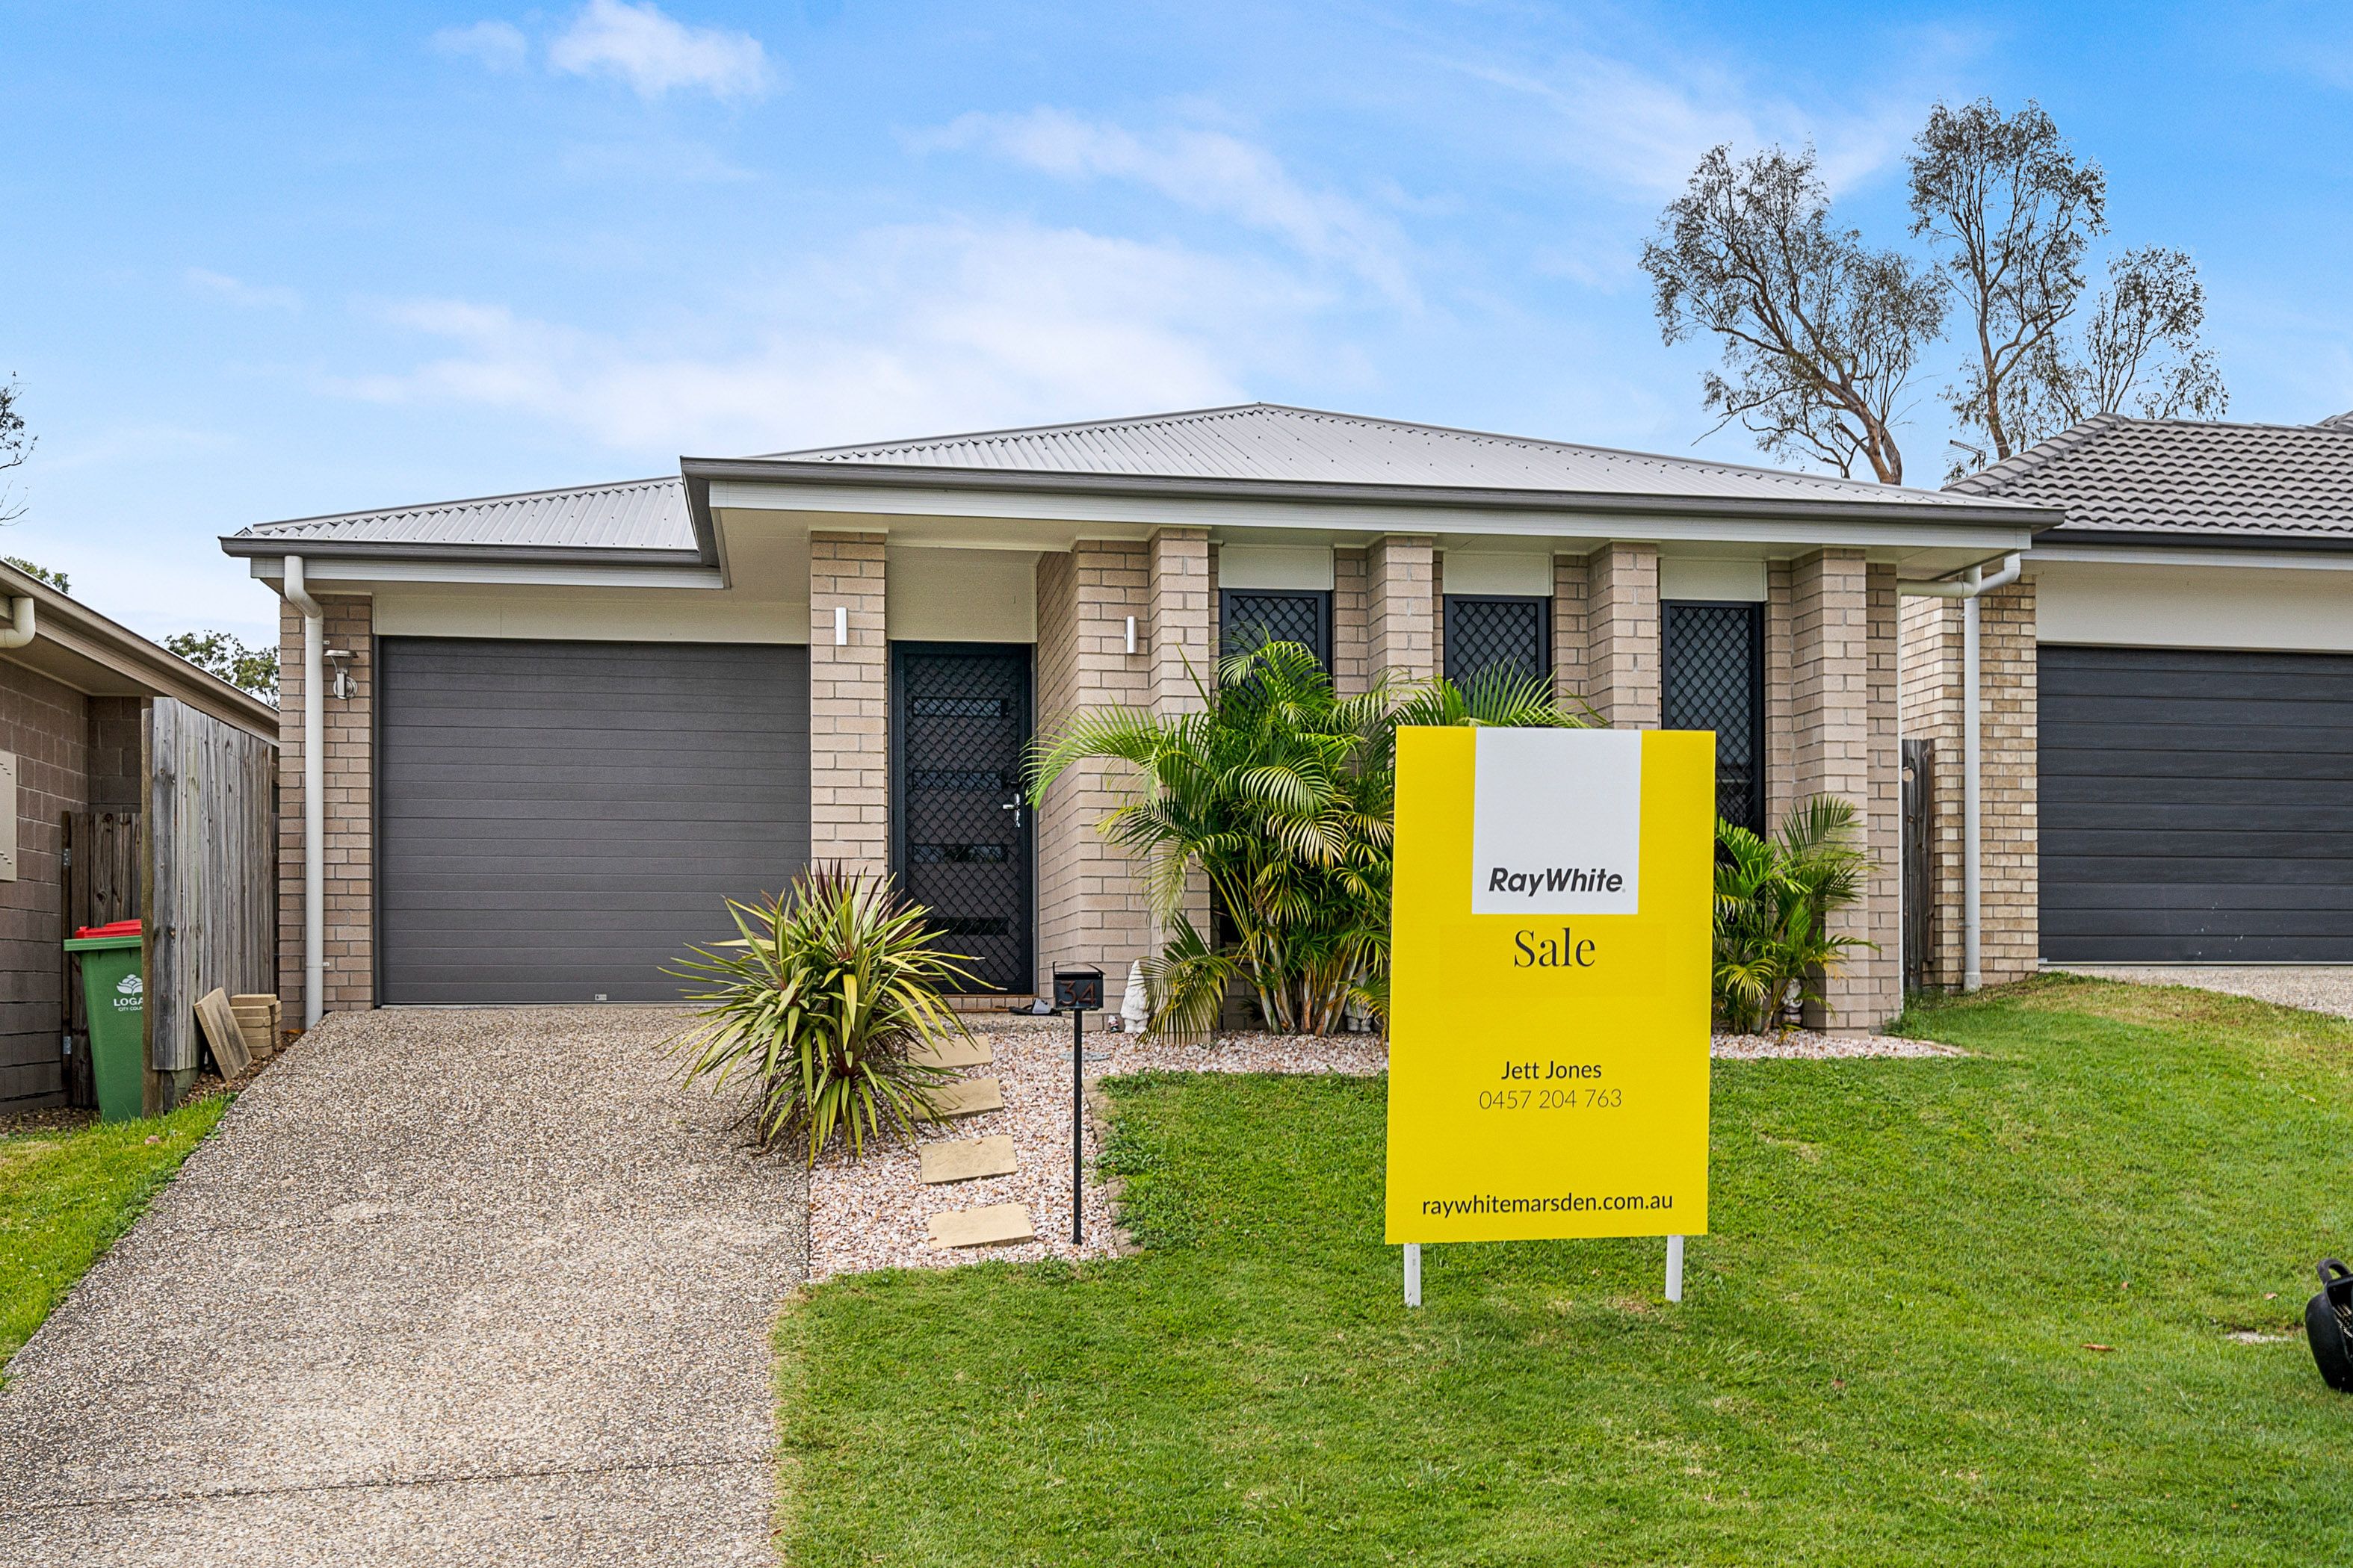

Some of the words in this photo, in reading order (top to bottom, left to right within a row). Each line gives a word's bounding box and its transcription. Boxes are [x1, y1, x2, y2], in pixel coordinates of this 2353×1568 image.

[1514, 927, 1596, 967] Sale
[1058, 980, 1096, 1006] 34
[1500, 1061, 1540, 1080] Jett
[1545, 1060, 1602, 1079] Jones
[1479, 1090, 1532, 1110] 0457
[1539, 1089, 1577, 1109] 204
[1585, 1088, 1621, 1109] 763
[1422, 1192, 1673, 1218] raywhitemarsden.com.au
